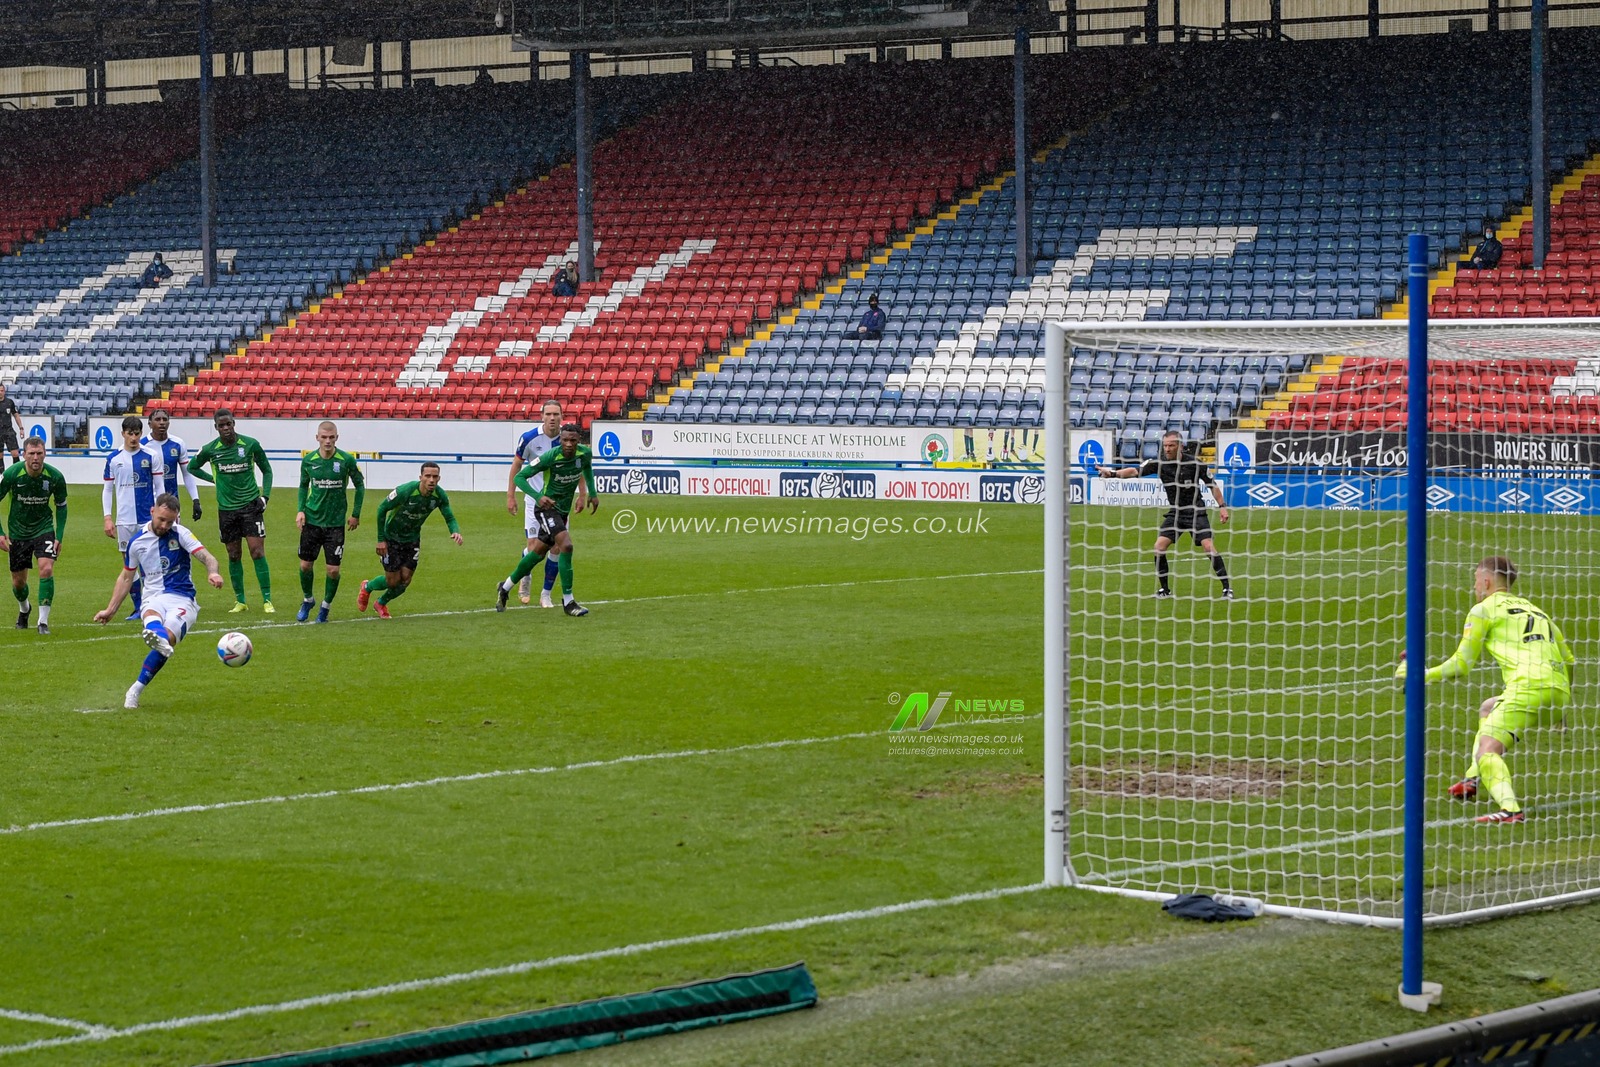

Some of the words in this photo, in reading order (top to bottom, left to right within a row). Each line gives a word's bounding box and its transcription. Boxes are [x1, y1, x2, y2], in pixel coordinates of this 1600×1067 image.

[673, 429, 731, 444] SPORTING
[736, 431, 808, 445] EXCELLENCE
[811, 433, 826, 446] AT
[829, 433, 907, 447] WESTHOLME
[712, 448, 739, 457] PROUD
[741, 449, 751, 457] TO
[753, 449, 786, 458] SUPPORT
[788, 450, 833, 459] BLACKBURN
[835, 451, 864, 460] ROVERS
[1359, 438, 1428, 467] Floo
[1494, 440, 1546, 461] ROVERS
[1551, 442, 1579, 462] NO.1
[593, 475, 619, 494] 1875
[649, 476, 680, 495] CLUB
[688, 477, 709, 494] IT'S
[713, 478, 771, 496] OFFICIAL!
[781, 479, 810, 497] 1875
[842, 480, 875, 499] CLUB
[884, 480, 917, 499] JOIN
[921, 481, 970, 500] TODAY!
[981, 482, 1012, 502] 1875
[1104, 479, 1120, 492] visit
